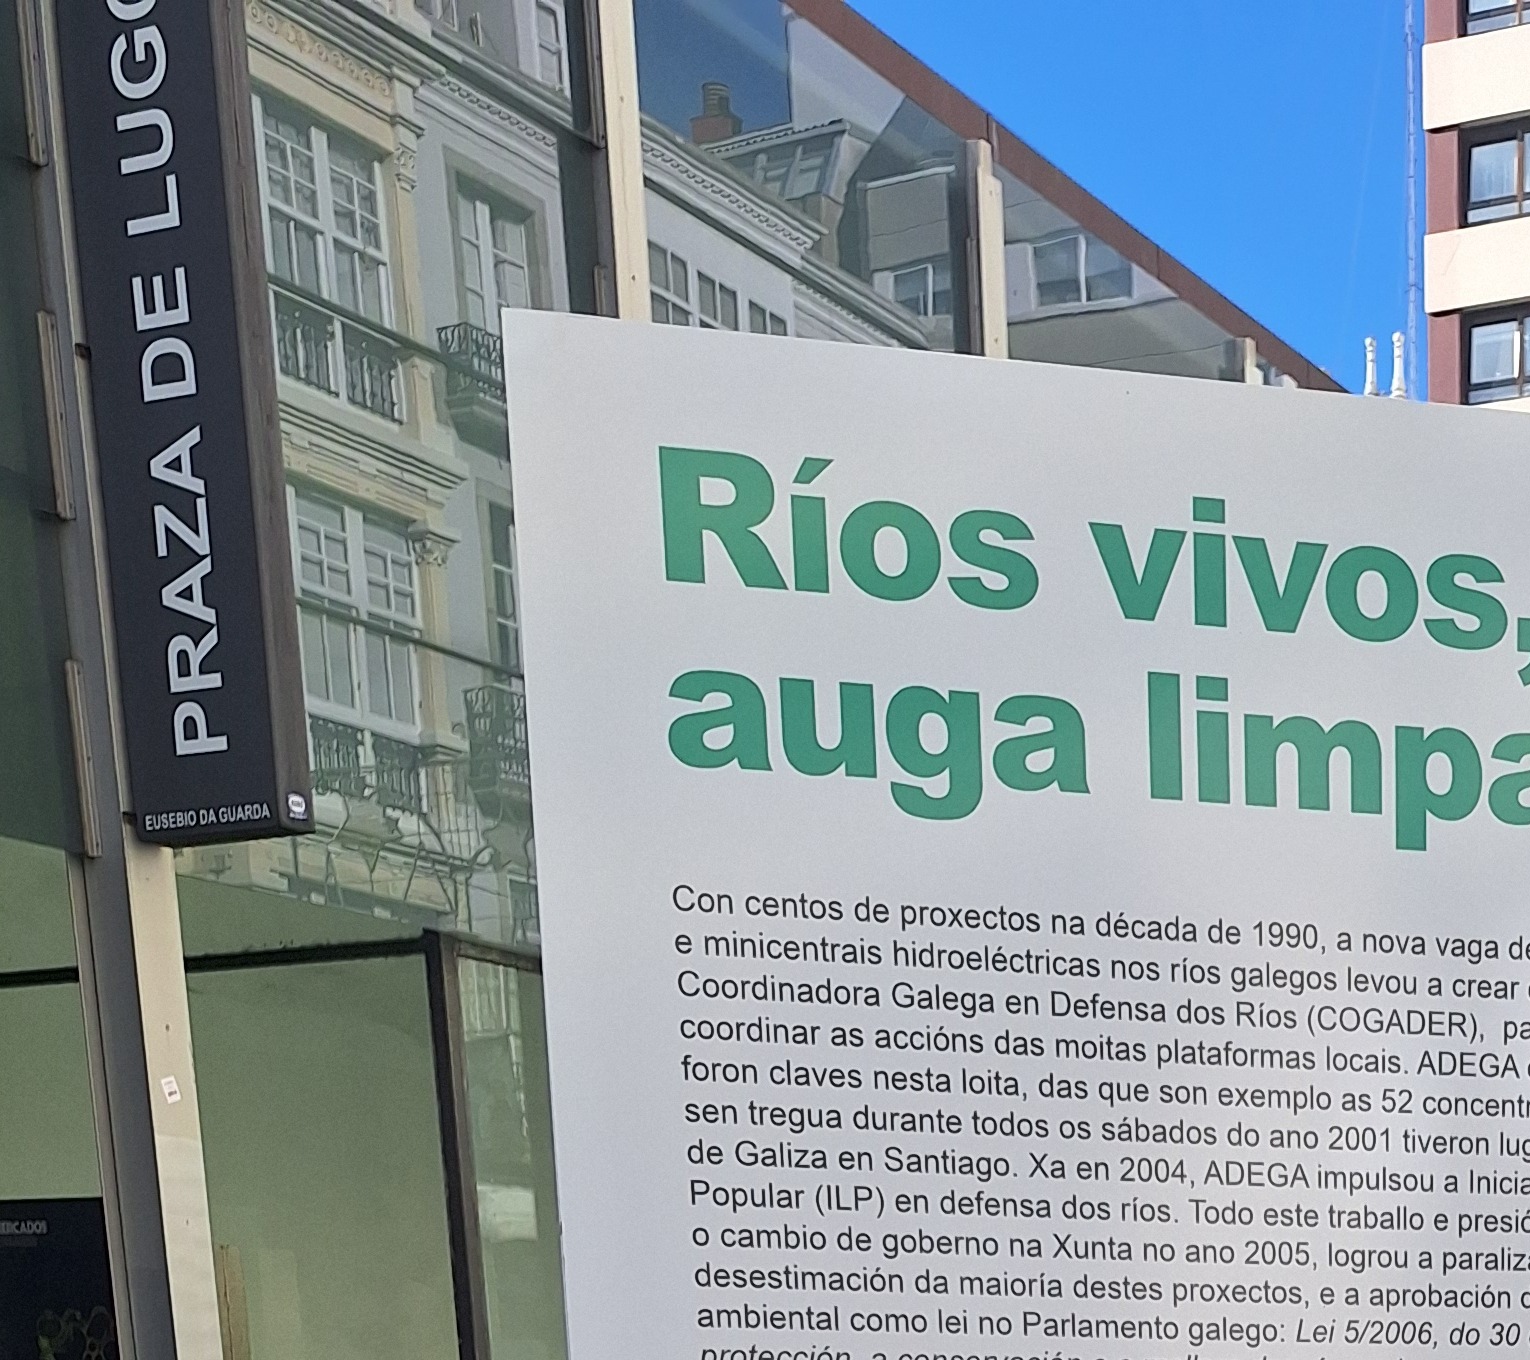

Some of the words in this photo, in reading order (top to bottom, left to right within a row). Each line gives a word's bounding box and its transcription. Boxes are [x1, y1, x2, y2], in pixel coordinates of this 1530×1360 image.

[107, 0, 181, 237] LUG
[132, 266, 197, 403] DE
[150, 425, 228, 756] PRAZA
[658, 445, 1040, 611] Ríos
[145, 811, 197, 831] EUSEBIO
[199, 809, 217, 825] DA
[218, 803, 270, 823] GUARDA
[667, 669, 1091, 821] auga
[672, 884, 734, 915] Con
[745, 893, 844, 921] centos
[854, 895, 890, 924] de
[900, 905, 1041, 933] proxectos
[1051, 914, 1085, 936] na
[1095, 911, 1198, 943] década
[1207, 918, 1241, 945] de
[1252, 921, 1326, 955] 1990,
[1336, 932, 1352, 952] a
[1362, 933, 1426, 956] nova
[1435, 937, 1499, 965] vaga
[674, 934, 693, 955] e
[704, 930, 882, 966] minicentrais
[893, 939, 1101, 978] hidroeléctricas
[1111, 959, 1160, 982] nos
[1170, 957, 1221, 985] ríos
[1230, 961, 1337, 996] galegos
[1347, 966, 1417, 996] levou
[1427, 977, 1443, 997] a
[1452, 978, 1520, 1000] crear
